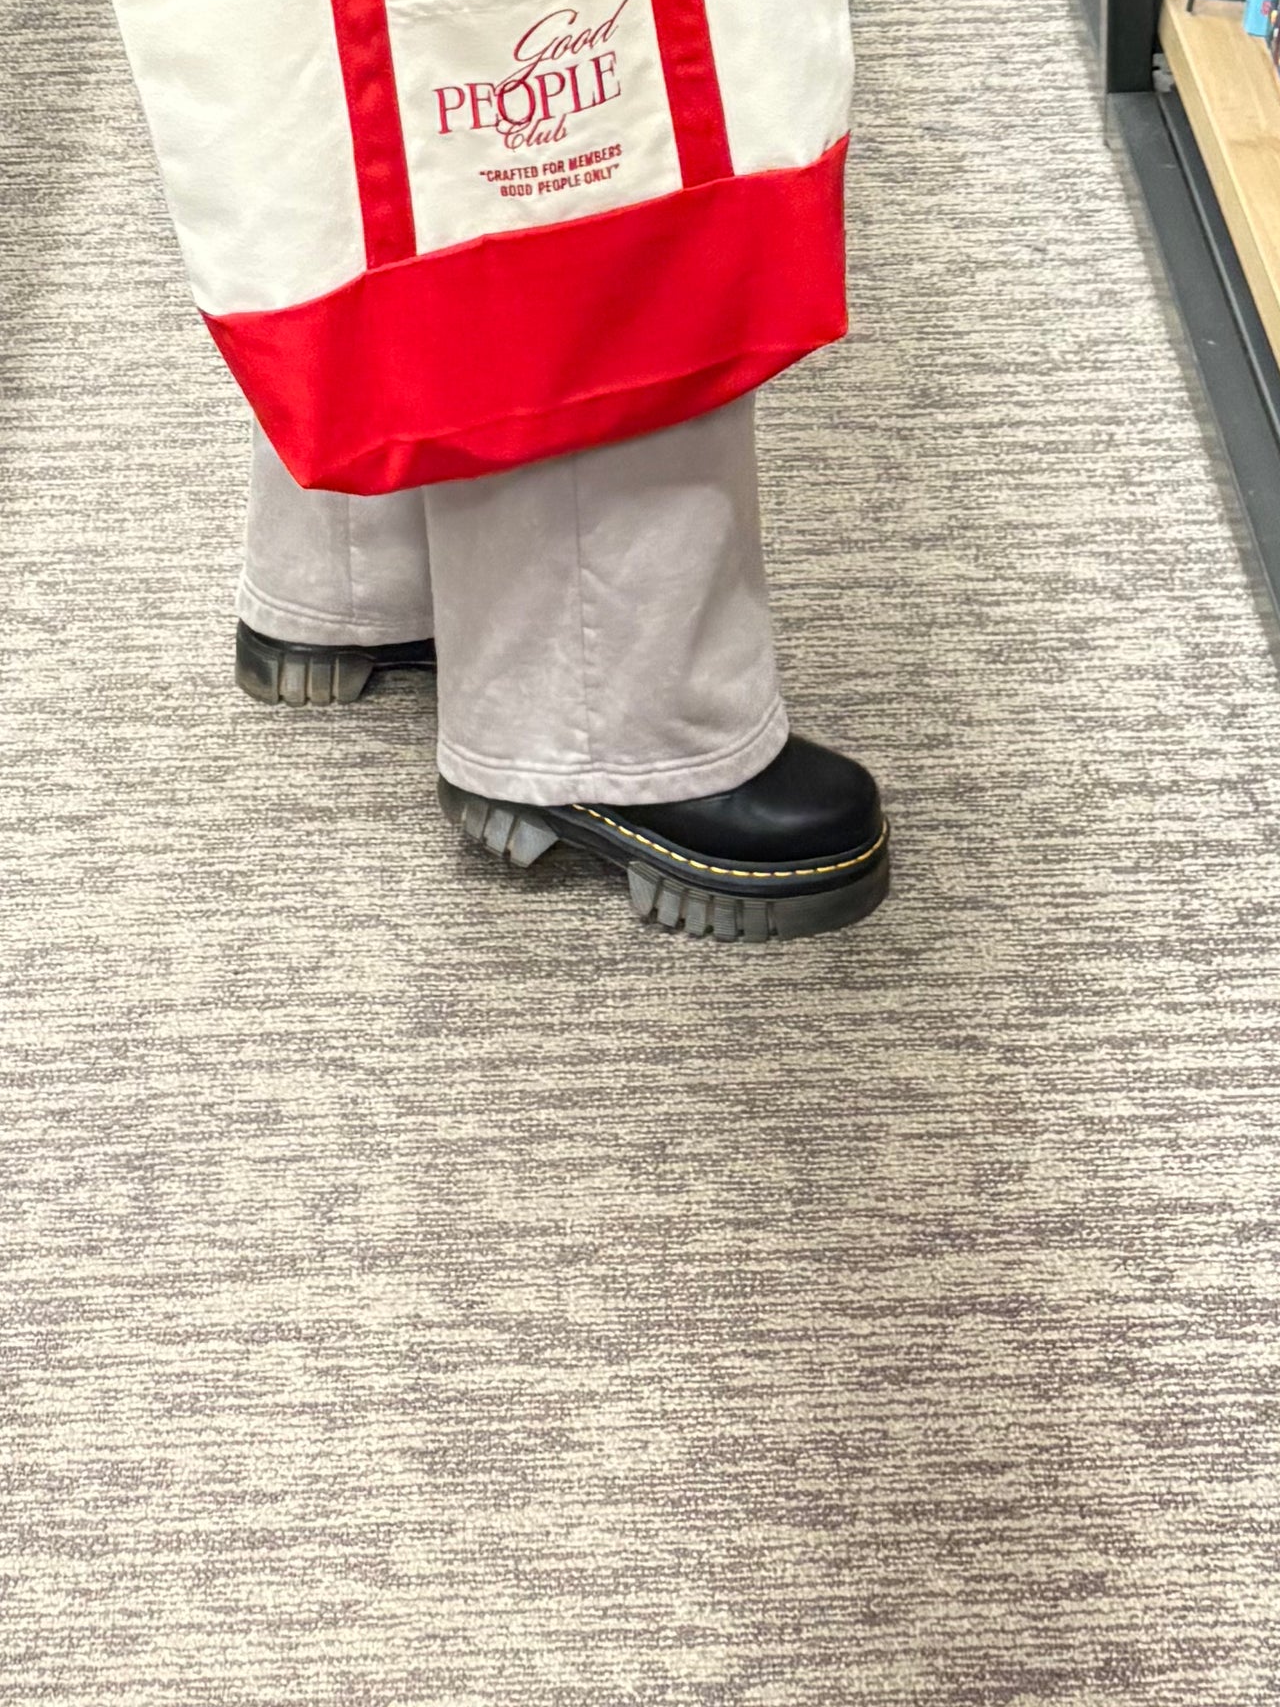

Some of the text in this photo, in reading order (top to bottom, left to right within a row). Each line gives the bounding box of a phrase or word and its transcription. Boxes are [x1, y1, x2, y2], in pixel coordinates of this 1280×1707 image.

[432, 51, 621, 135] PEOPLE
[496, 112, 568, 150] Club
[542, 160, 565, 175] FOR
[568, 144, 622, 171] MEMBERS
[500, 184, 532, 198] GOOD
[537, 175, 581, 195] PEOPLE
